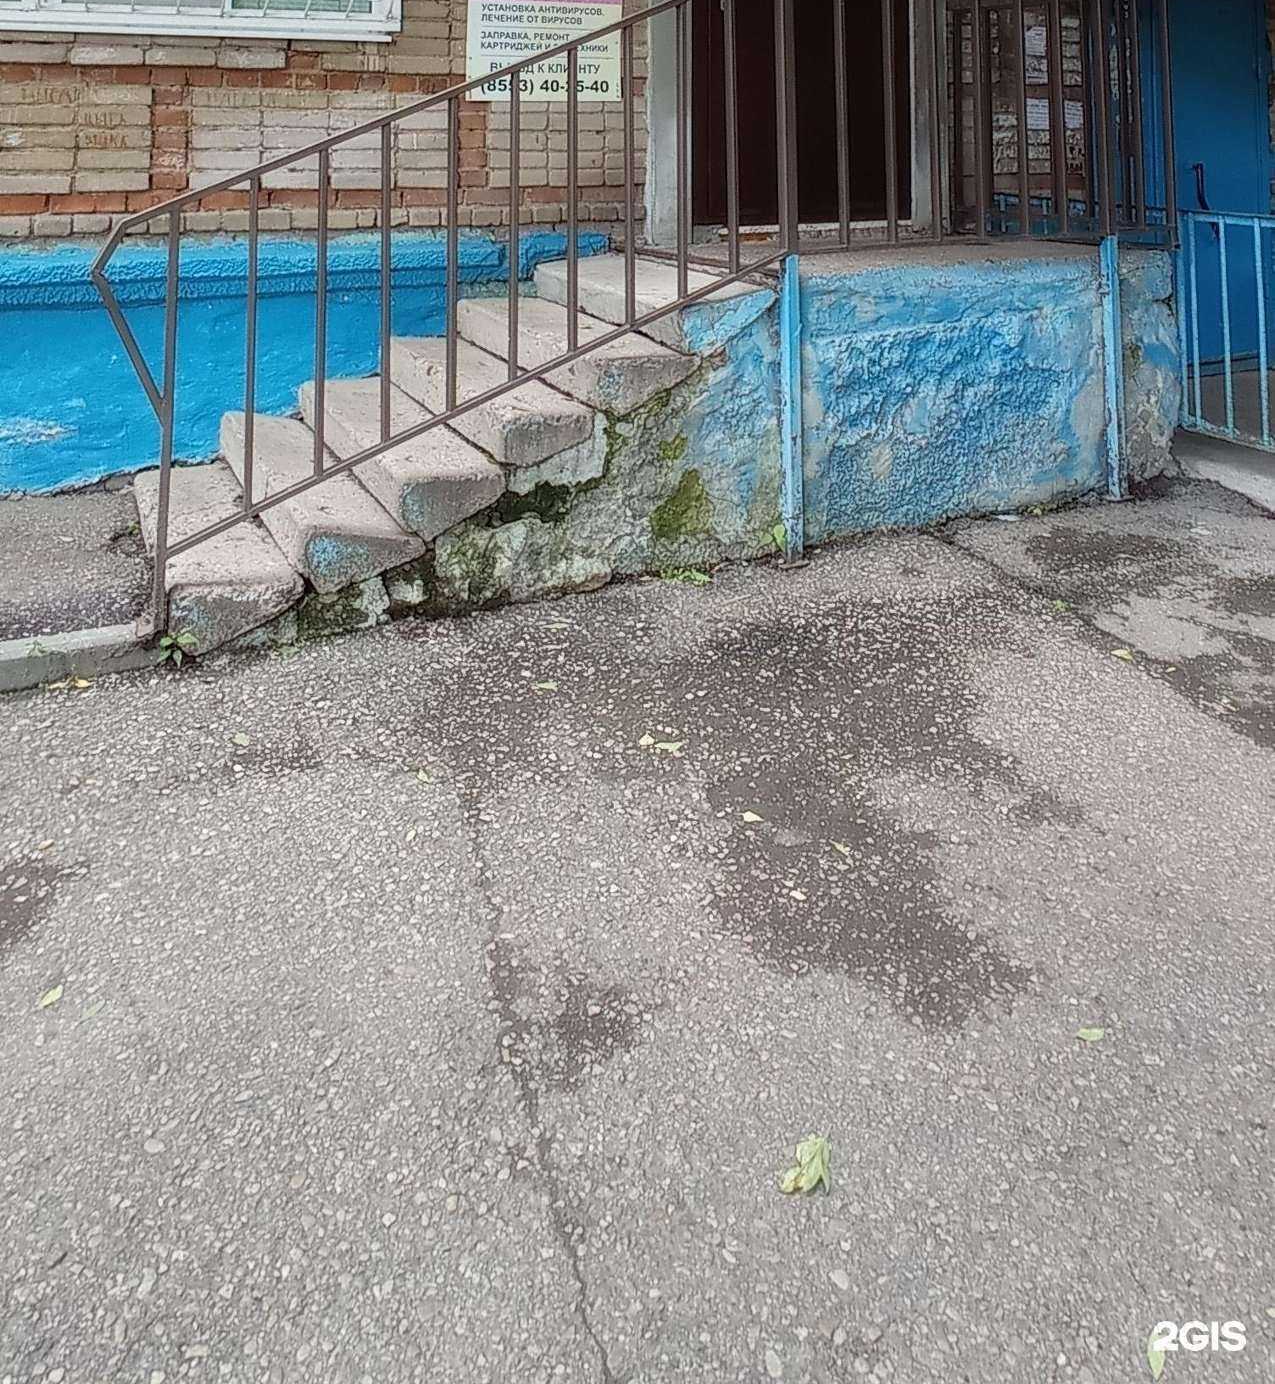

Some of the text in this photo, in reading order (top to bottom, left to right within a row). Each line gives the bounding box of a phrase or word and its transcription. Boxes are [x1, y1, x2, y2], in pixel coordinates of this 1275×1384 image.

[481, 4, 535, 12] УСТАНОВКА
[481, 15, 583, 25] ЛЕЧЕНИЕ ОТ ВИРУСОВ
[534, 33, 570, 41] РЕМОНТ
[481, 40, 542, 51] КАРТРИДЖЕЙ
[538, 63, 545, 73] К
[548, 63, 600, 75] КЛИНТУ
[540, 80, 609, 93] 40-5-40
